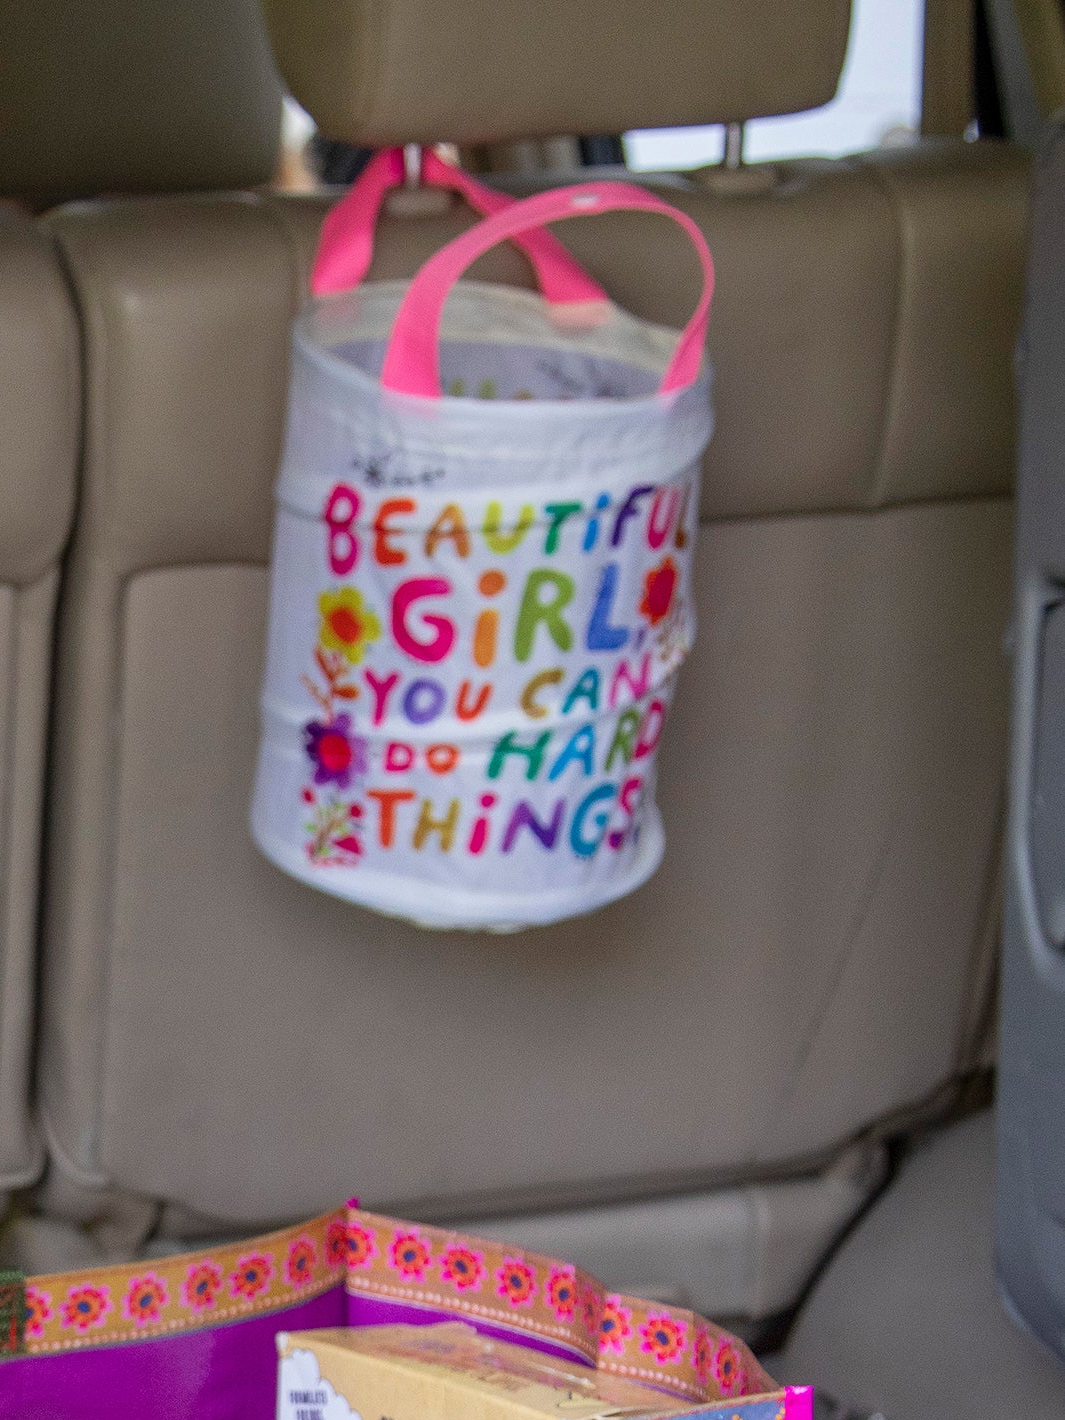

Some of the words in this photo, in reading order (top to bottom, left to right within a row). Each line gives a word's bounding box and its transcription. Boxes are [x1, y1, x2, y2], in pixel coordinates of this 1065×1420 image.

[362, 667, 494, 727] YOU
[519, 653, 652, 720] CAN
[383, 740, 461, 775] DO
[486, 699, 665, 782] HARD
